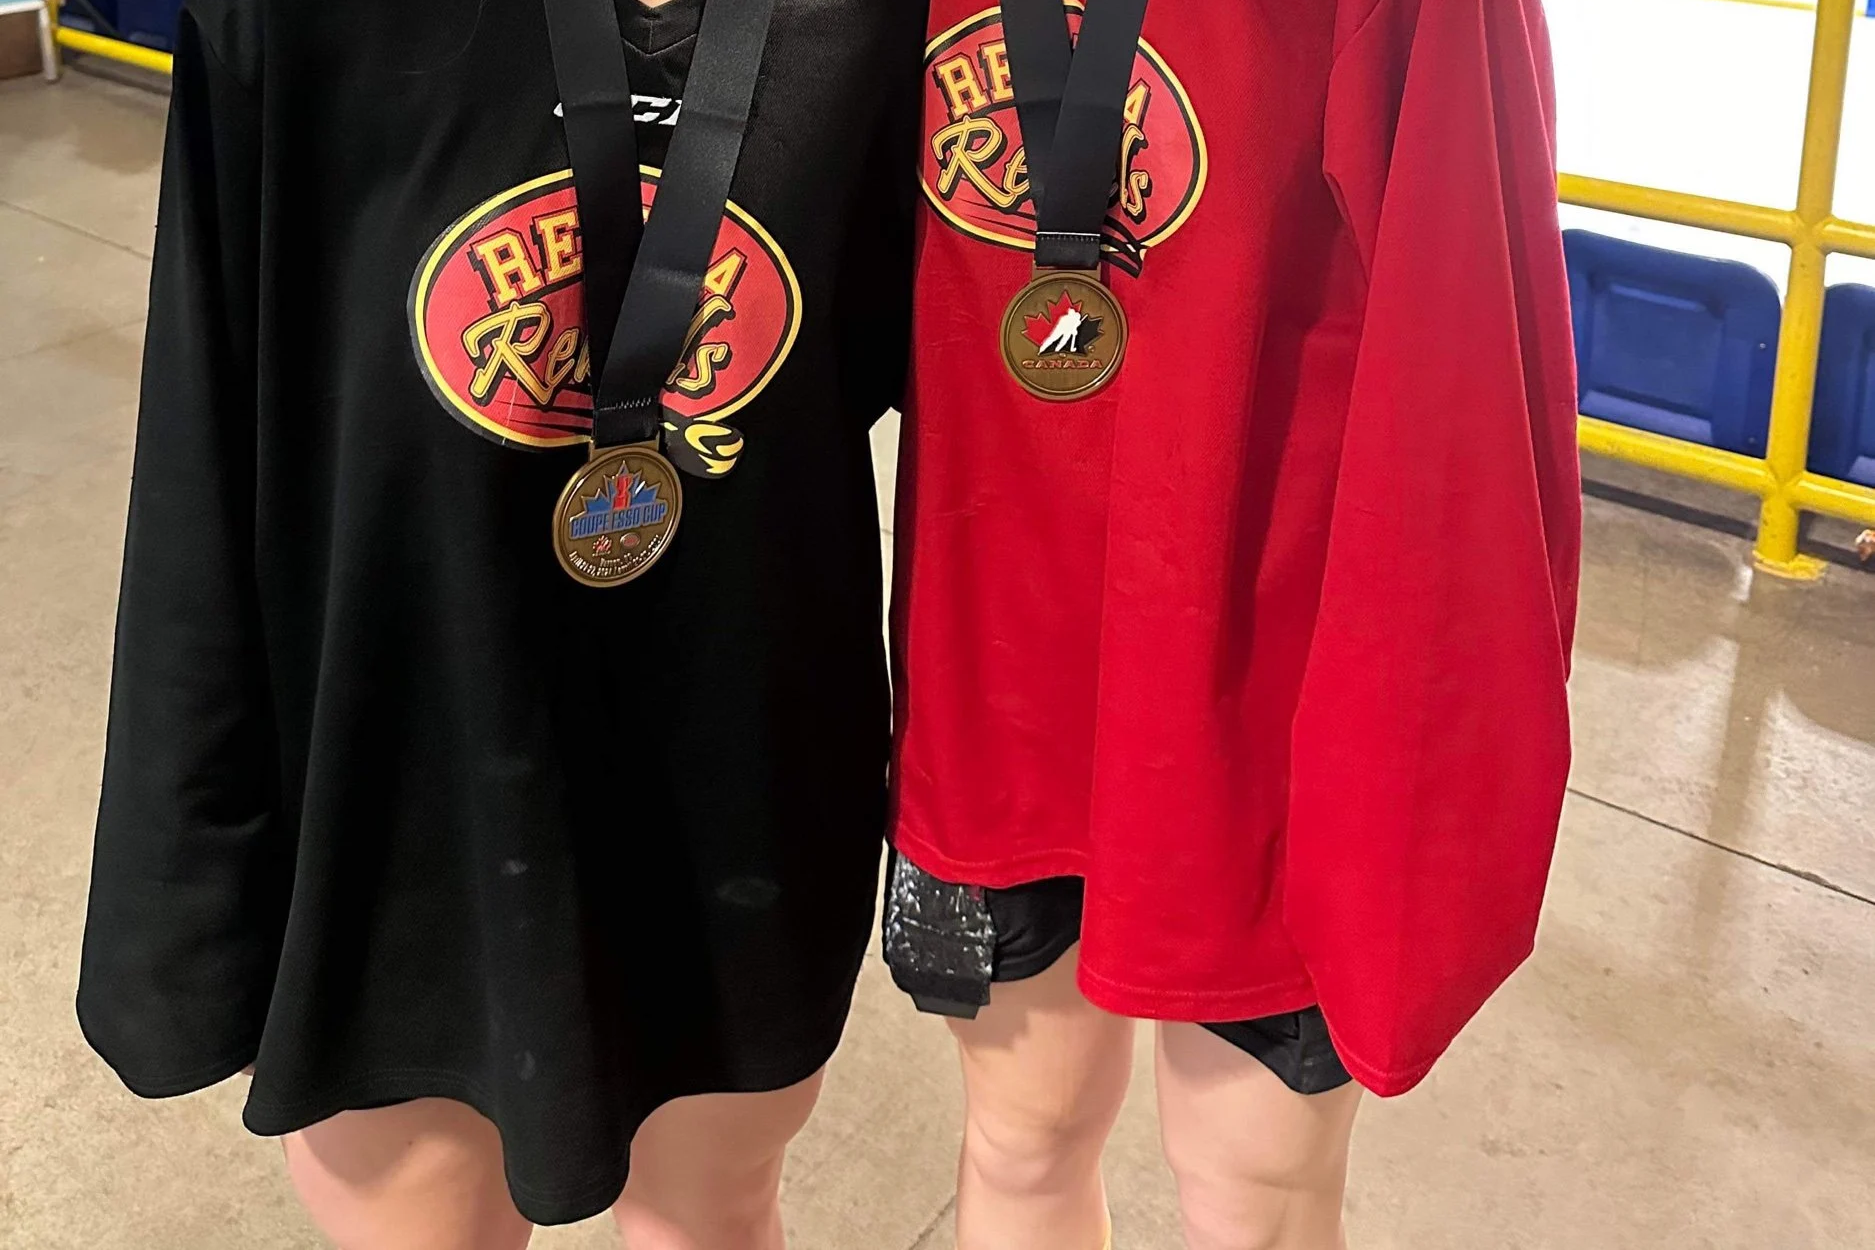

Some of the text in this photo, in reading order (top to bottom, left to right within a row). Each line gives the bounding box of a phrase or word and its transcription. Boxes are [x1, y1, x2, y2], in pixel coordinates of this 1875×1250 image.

[1022, 359, 1103, 369] CANADA
[571, 502, 666, 537] COUPE ESSO CUP
